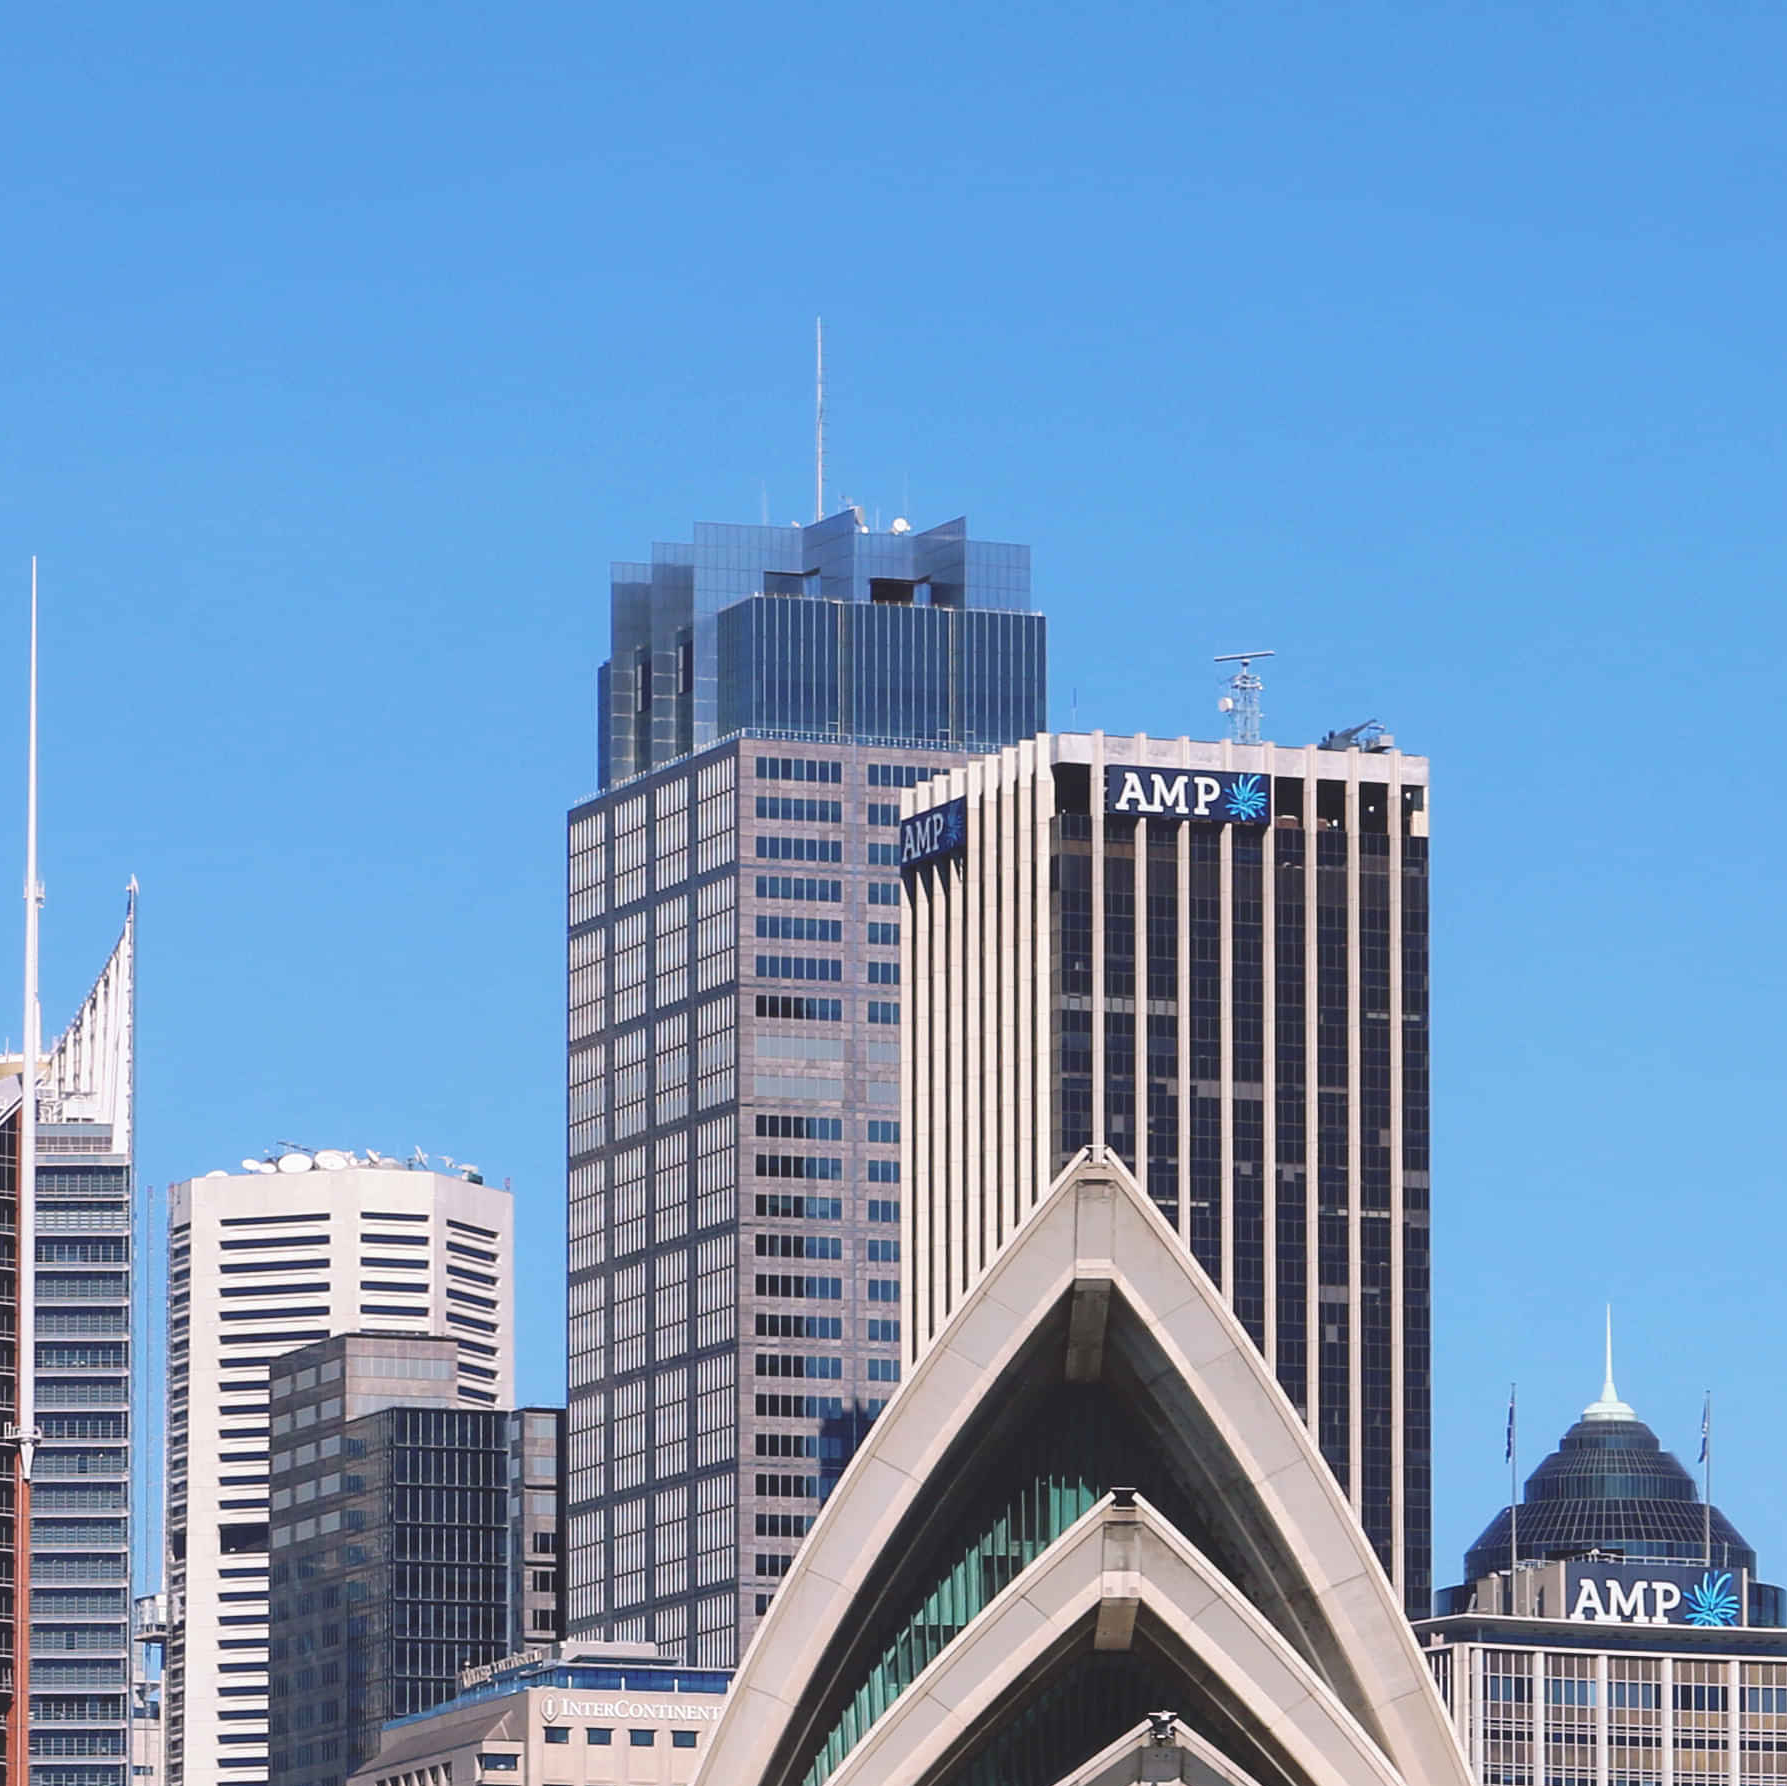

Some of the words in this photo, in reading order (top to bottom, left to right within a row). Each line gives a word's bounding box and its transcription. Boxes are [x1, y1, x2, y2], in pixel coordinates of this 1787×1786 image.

[1115, 772, 1221, 815] AMP
[902, 813, 944, 863] AMP
[1570, 1578, 1681, 1624] AMP
[560, 1699, 722, 1721] INTERCONTINENT
